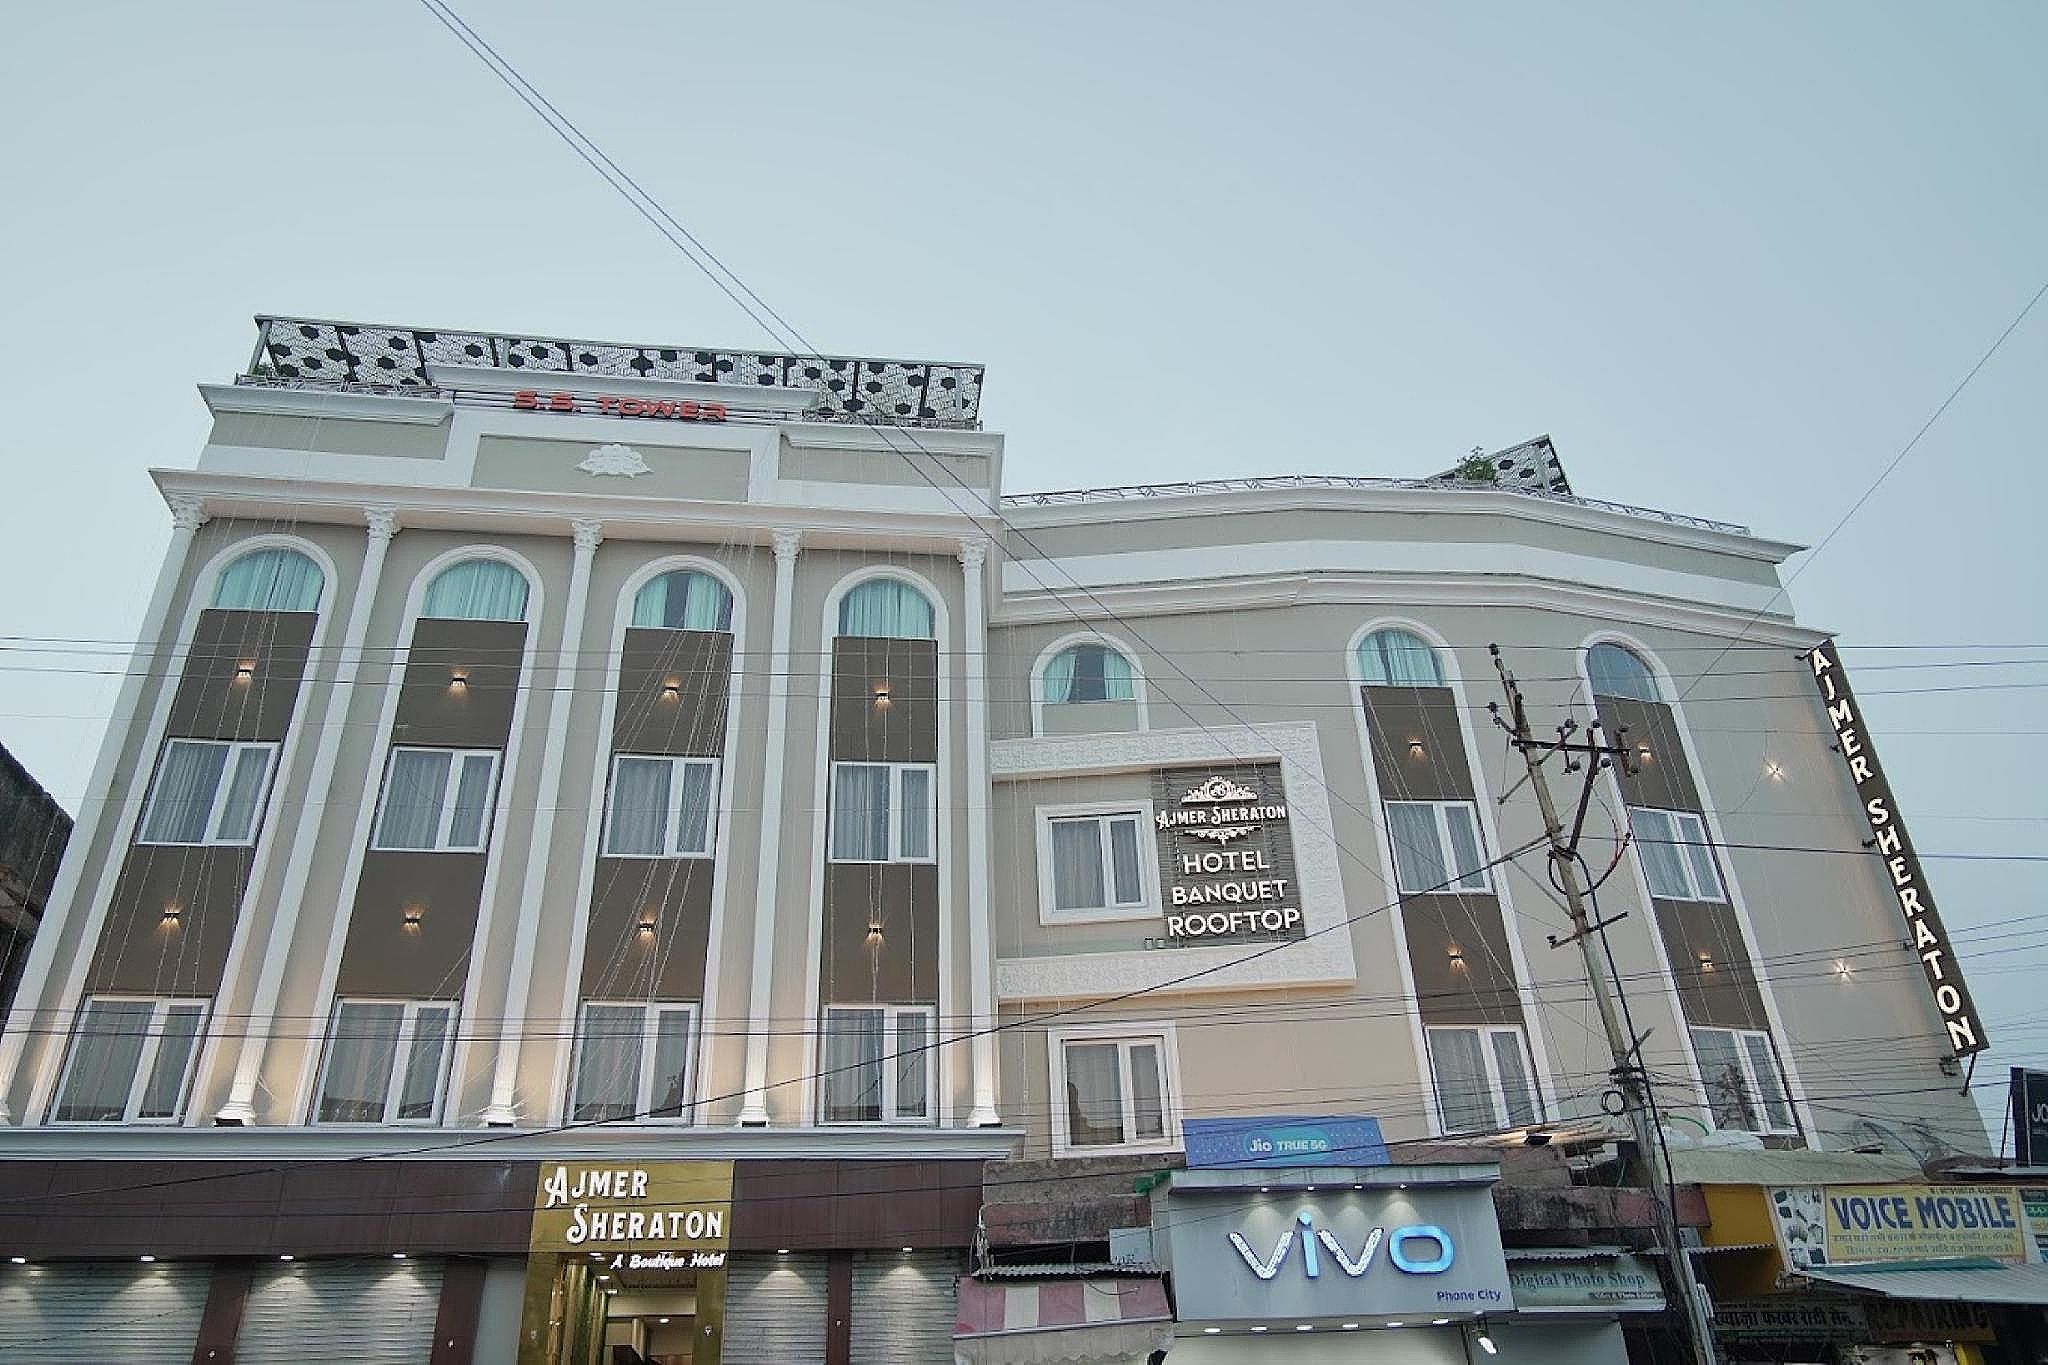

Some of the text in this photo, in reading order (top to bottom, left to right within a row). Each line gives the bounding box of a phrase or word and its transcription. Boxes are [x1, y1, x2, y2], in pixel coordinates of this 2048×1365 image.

[596, 396, 727, 422] TOWER
[1156, 805, 1287, 829] AJMER SHERATON
[1183, 850, 1270, 875] HOTEL
[1811, 649, 1978, 1050] AJMER SHERATON
[1172, 879, 1288, 905] BANQUET
[1167, 908, 1300, 937] ROOFTOP
[1250, 1137, 1273, 1152] Jio
[544, 1166, 649, 1208] AJMER
[566, 1203, 724, 1244] SHERATON
[1831, 1195, 2017, 1231] VOICE MOBILE
[1228, 1211, 1455, 1280] vivo
[690, 1252, 726, 1268] Hotel
[1511, 1271, 1646, 1291] Digital Photo Shop
[1436, 1288, 1502, 1303] Phone City
